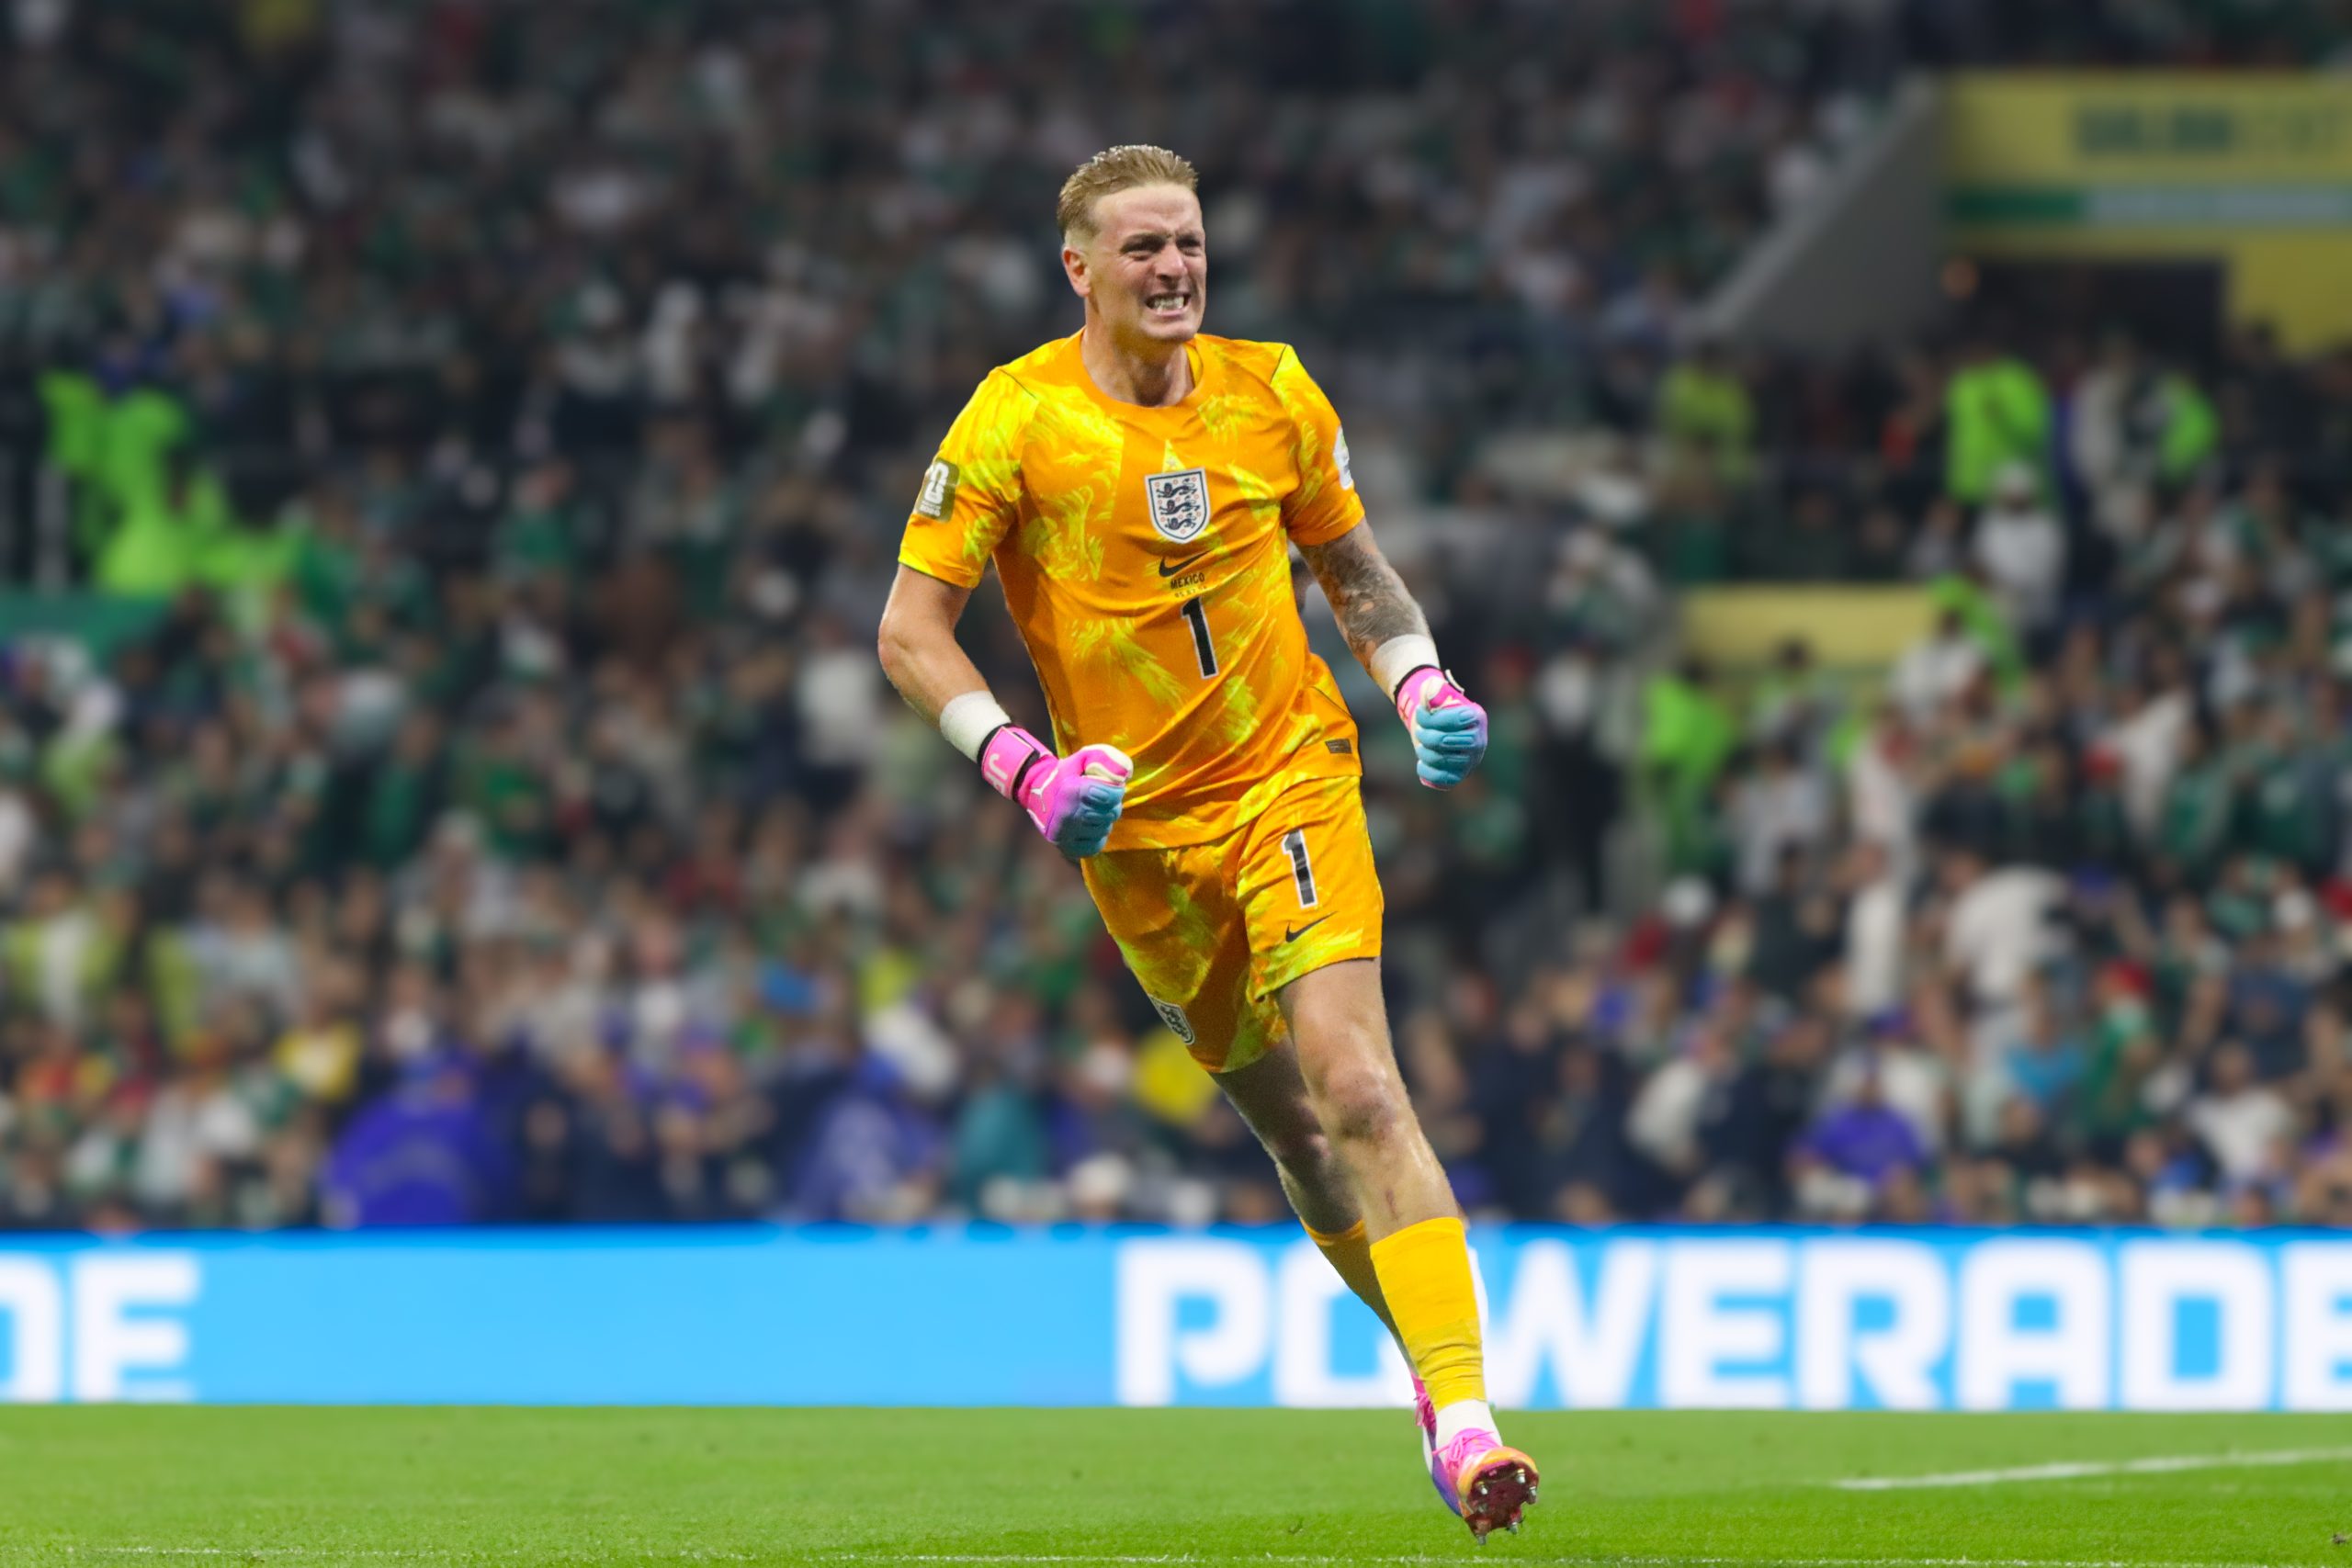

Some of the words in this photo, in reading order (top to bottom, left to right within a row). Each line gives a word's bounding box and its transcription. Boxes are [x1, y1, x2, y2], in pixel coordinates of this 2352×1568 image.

[1170, 572, 1205, 589] MEXICO
[1181, 596, 1219, 679] 1
[1281, 828, 1318, 909] 1
[1116, 1238, 2352, 1410] POWERADE
